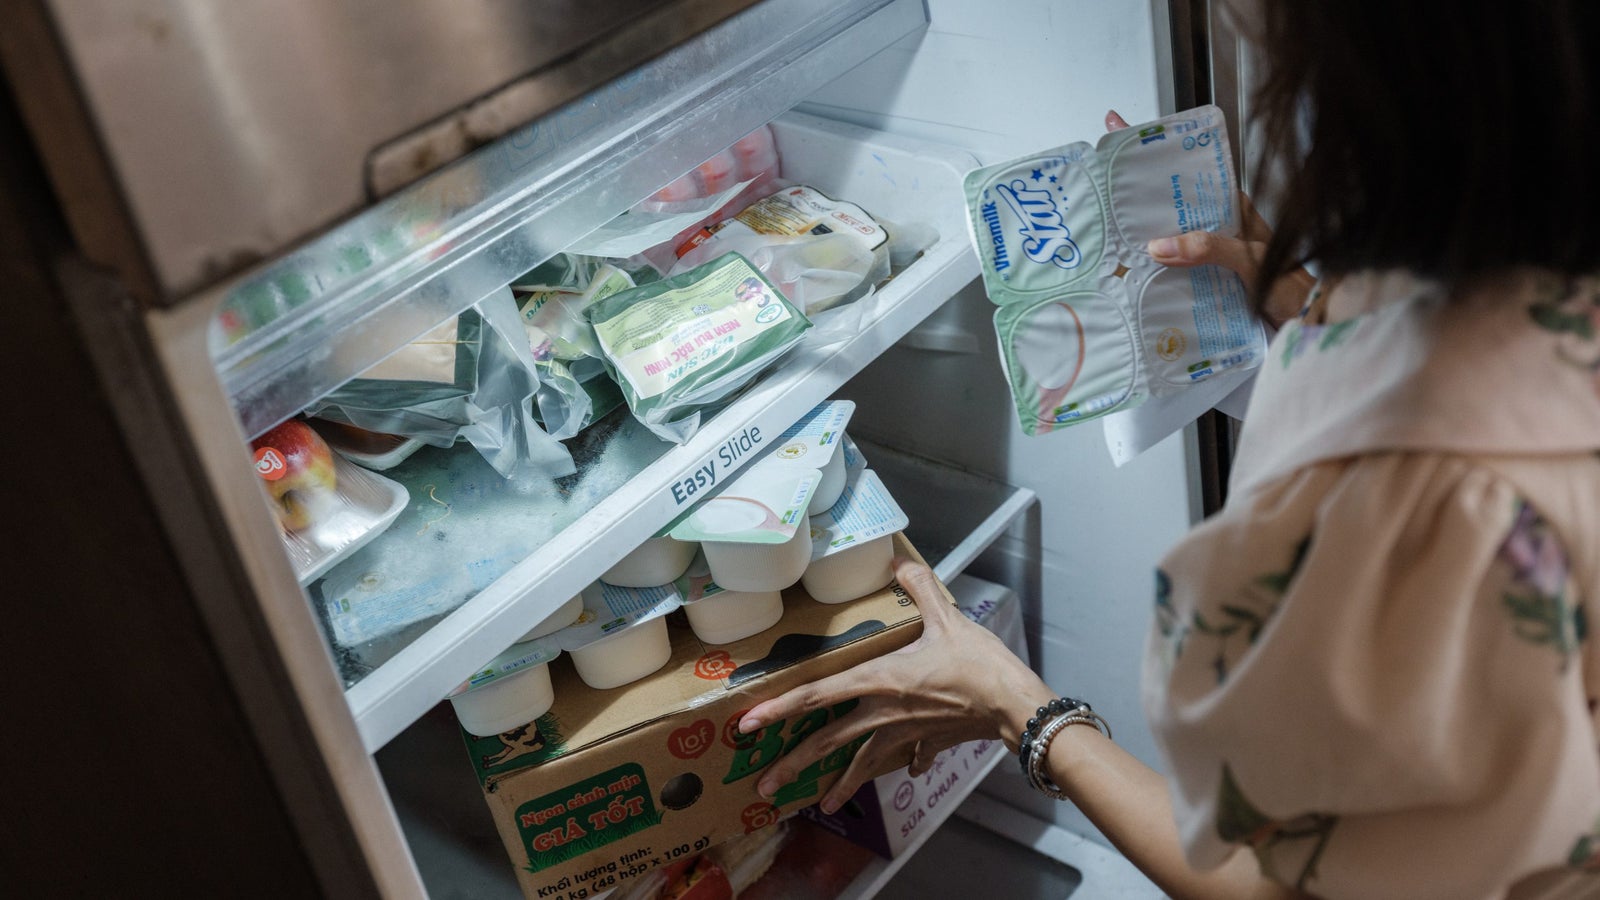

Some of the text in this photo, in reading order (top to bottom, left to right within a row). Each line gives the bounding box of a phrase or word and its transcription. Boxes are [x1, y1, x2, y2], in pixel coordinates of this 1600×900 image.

[981, 201, 1011, 272] Vinamilk
[995, 178, 1082, 270] Star
[713, 319, 741, 337] NEM
[643, 357, 672, 376] NINH
[670, 426, 763, 506] Easy Slide
[677, 726, 710, 751] lof
[520, 774, 642, 828] Ngon sánh mịn
[927, 772, 959, 809] CHUA
[532, 795, 645, 852] GIÁ TỐT
[537, 877, 571, 899] Khối
[574, 861, 617, 884] lượng
[568, 836, 710, 900] kg (48 hộp x 100 g)
